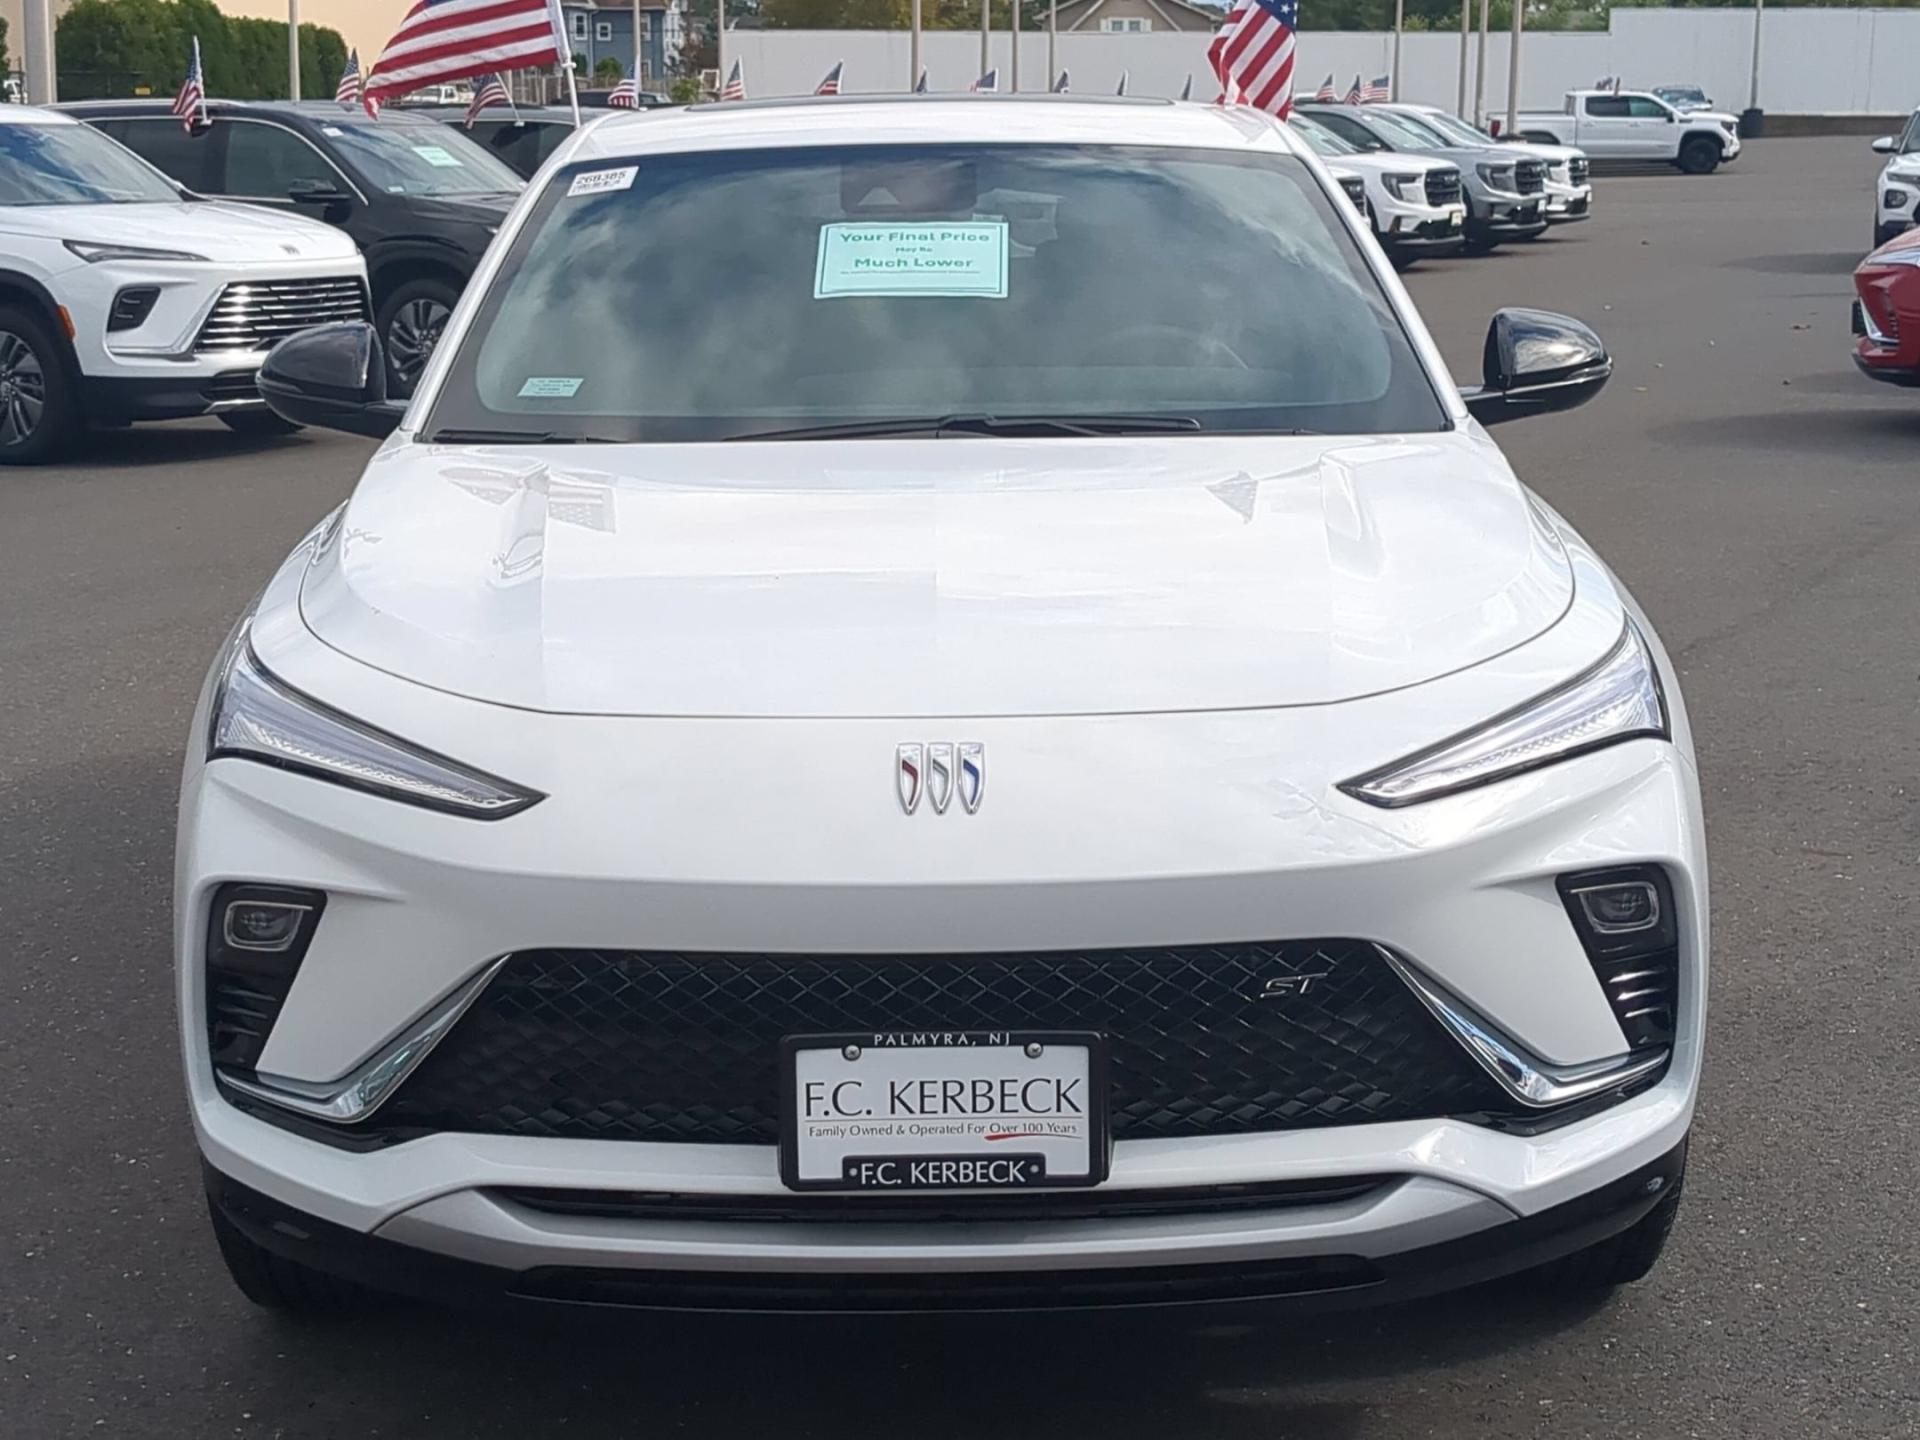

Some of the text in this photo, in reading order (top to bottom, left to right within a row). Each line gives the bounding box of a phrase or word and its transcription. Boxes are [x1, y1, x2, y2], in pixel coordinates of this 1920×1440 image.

[840, 232, 990, 242] Your Final Price
[854, 258, 973, 268] Much Lower
[1260, 972, 1328, 998] ST
[874, 1032, 1011, 1047] PALMYRA, NJ
[805, 1078, 1082, 1117] F.C. KERBECK
[809, 1122, 1077, 1139] Family Owned & Operated For Over 100 Years
[860, 1161, 1026, 1185] F.C. KERBECK
